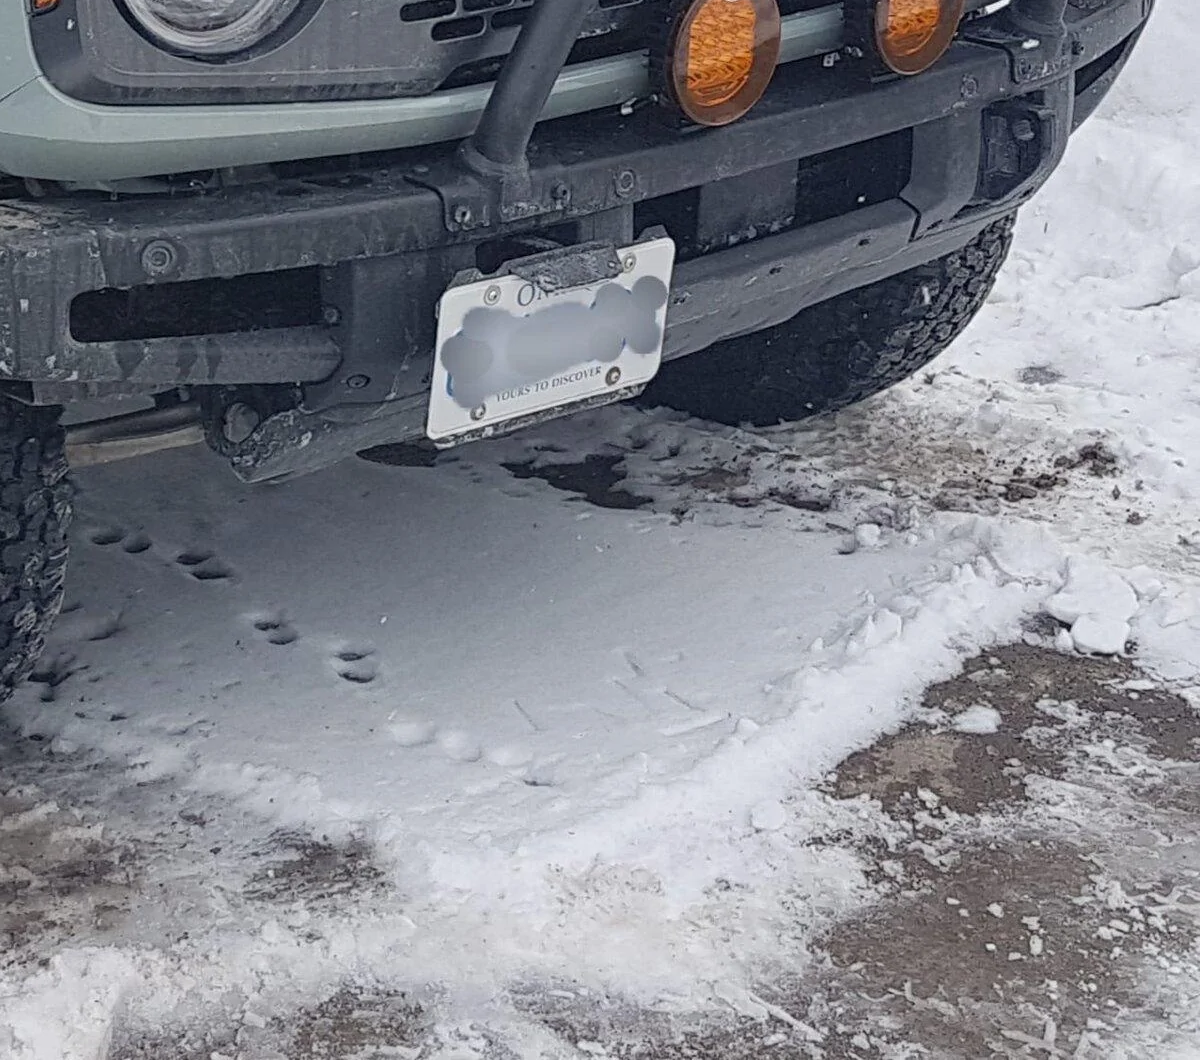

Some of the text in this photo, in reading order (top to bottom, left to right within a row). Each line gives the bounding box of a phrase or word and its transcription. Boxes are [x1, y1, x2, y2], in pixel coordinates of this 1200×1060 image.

[496, 365, 602, 402] YOURS TO DISCOVER
